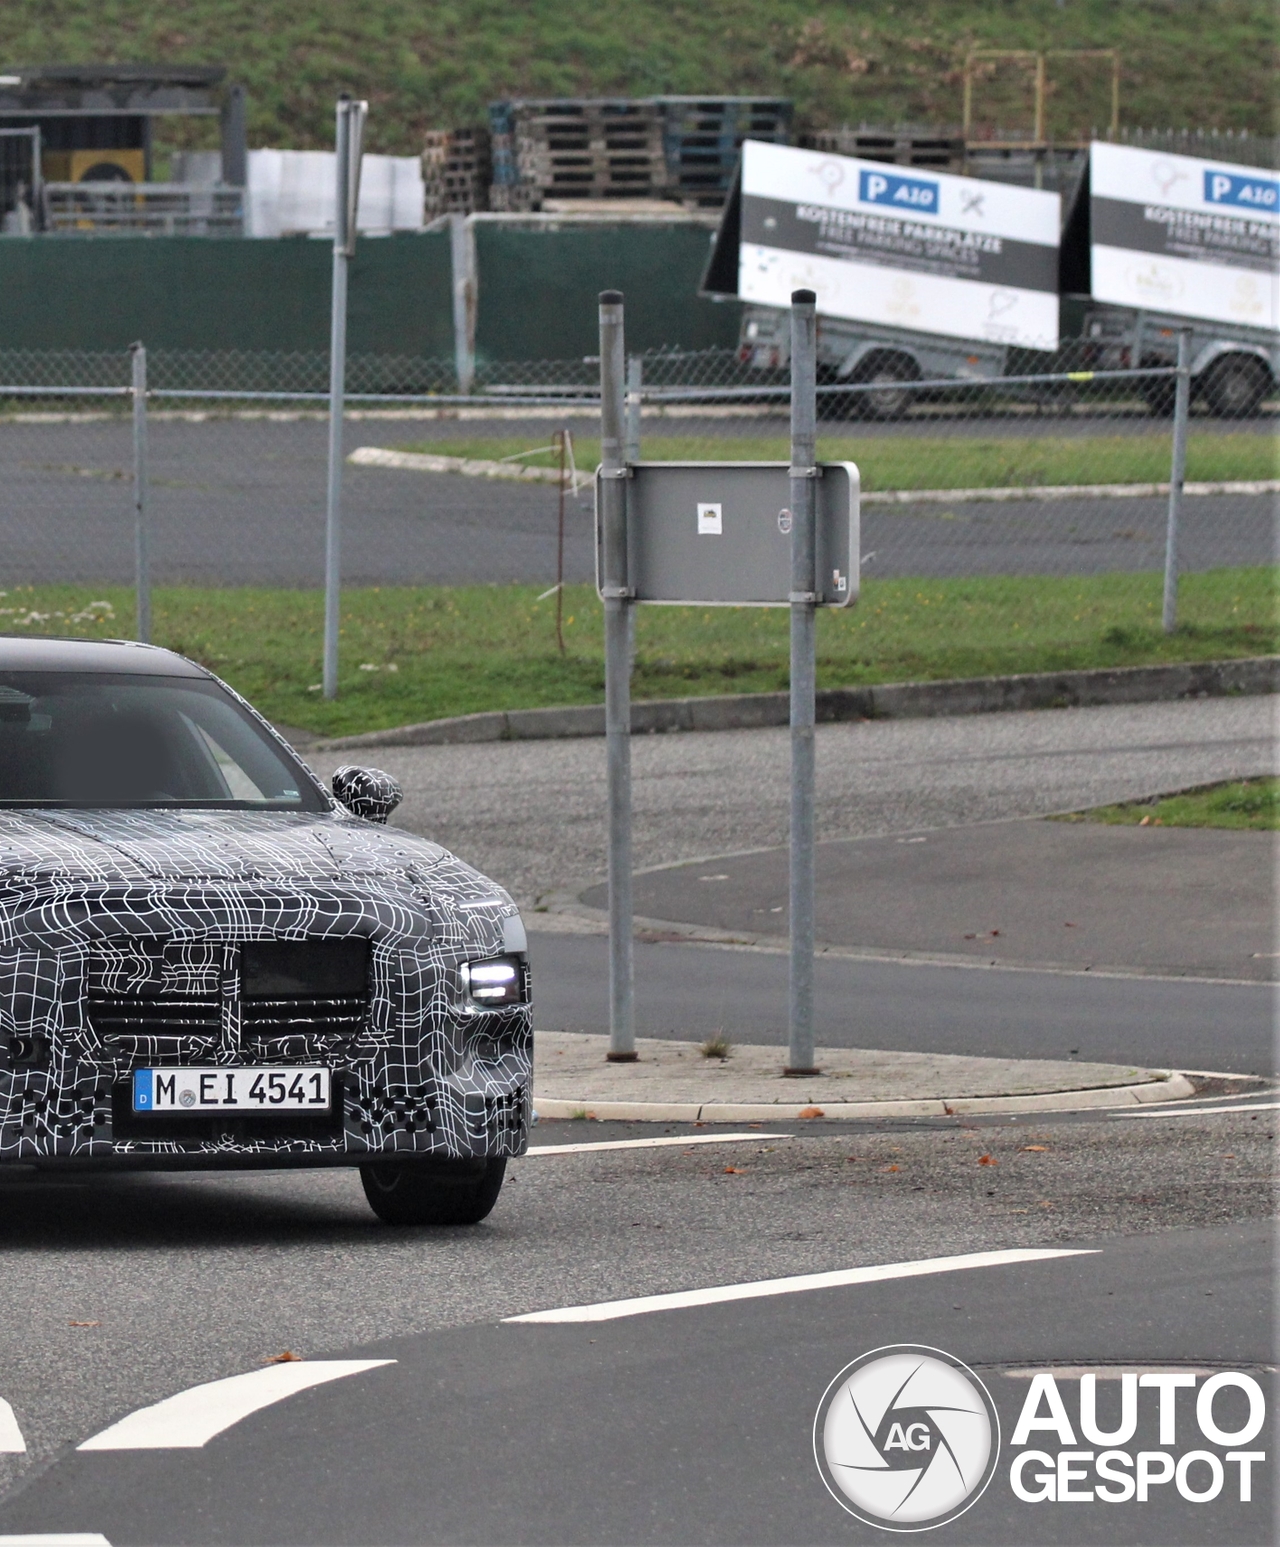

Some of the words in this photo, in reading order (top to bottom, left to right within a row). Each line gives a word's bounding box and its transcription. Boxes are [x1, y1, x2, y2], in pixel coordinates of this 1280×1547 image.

[867, 174, 888, 201] P
[893, 184, 934, 206] A10
[1212, 174, 1231, 201] P
[1238, 184, 1277, 206] A10
[796, 204, 901, 235] KOSTENFREIE
[1144, 204, 1246, 236] KOSTENFREIE
[139, 1094, 148, 1104] D
[156, 1074, 176, 1105] M
[200, 1073, 238, 1104] EI
[249, 1073, 326, 1104] 4541
